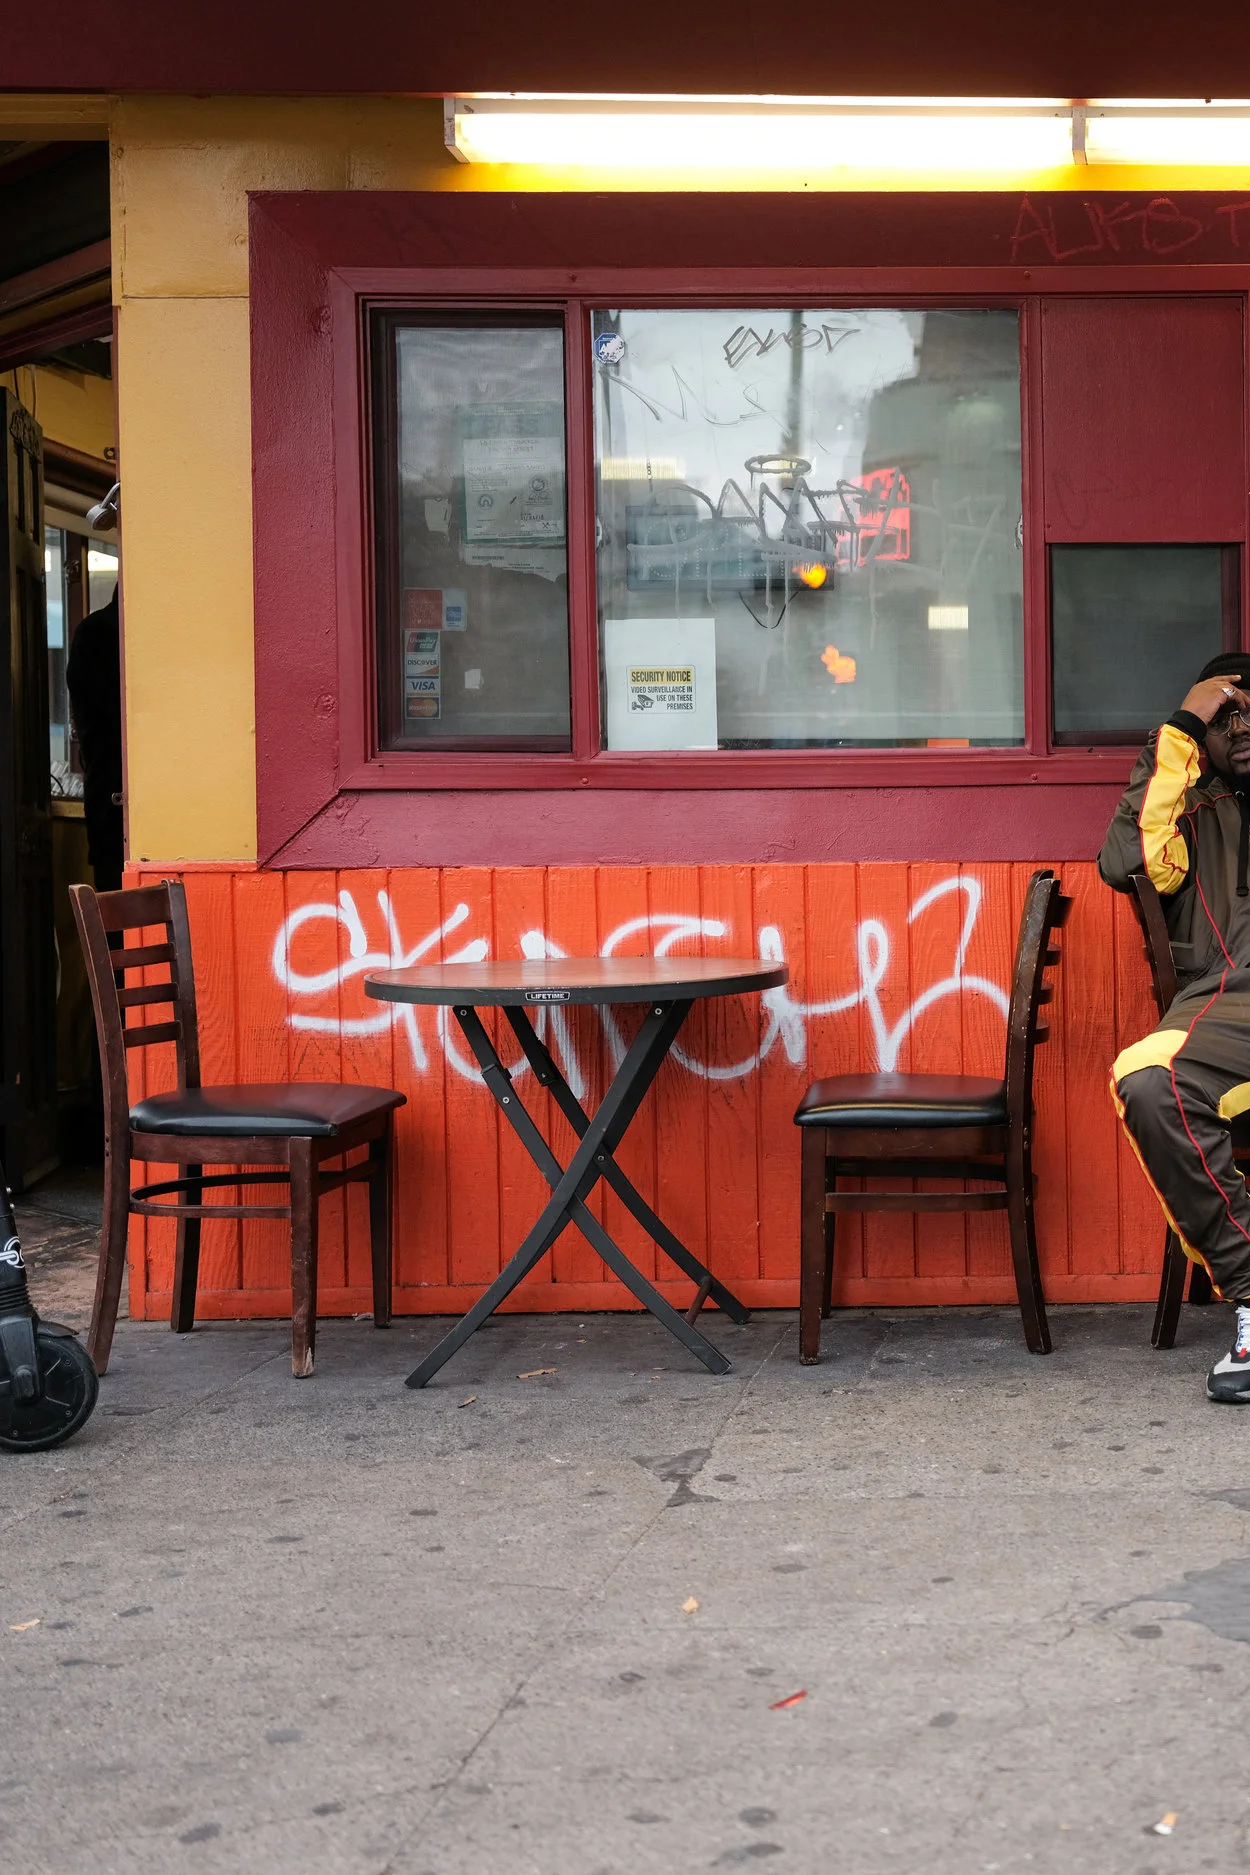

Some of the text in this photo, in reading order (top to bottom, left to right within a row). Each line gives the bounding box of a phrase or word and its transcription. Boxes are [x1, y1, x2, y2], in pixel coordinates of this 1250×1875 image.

[631, 671, 691, 682] SECURITY NOTICE
[411, 681, 436, 691] VISA
